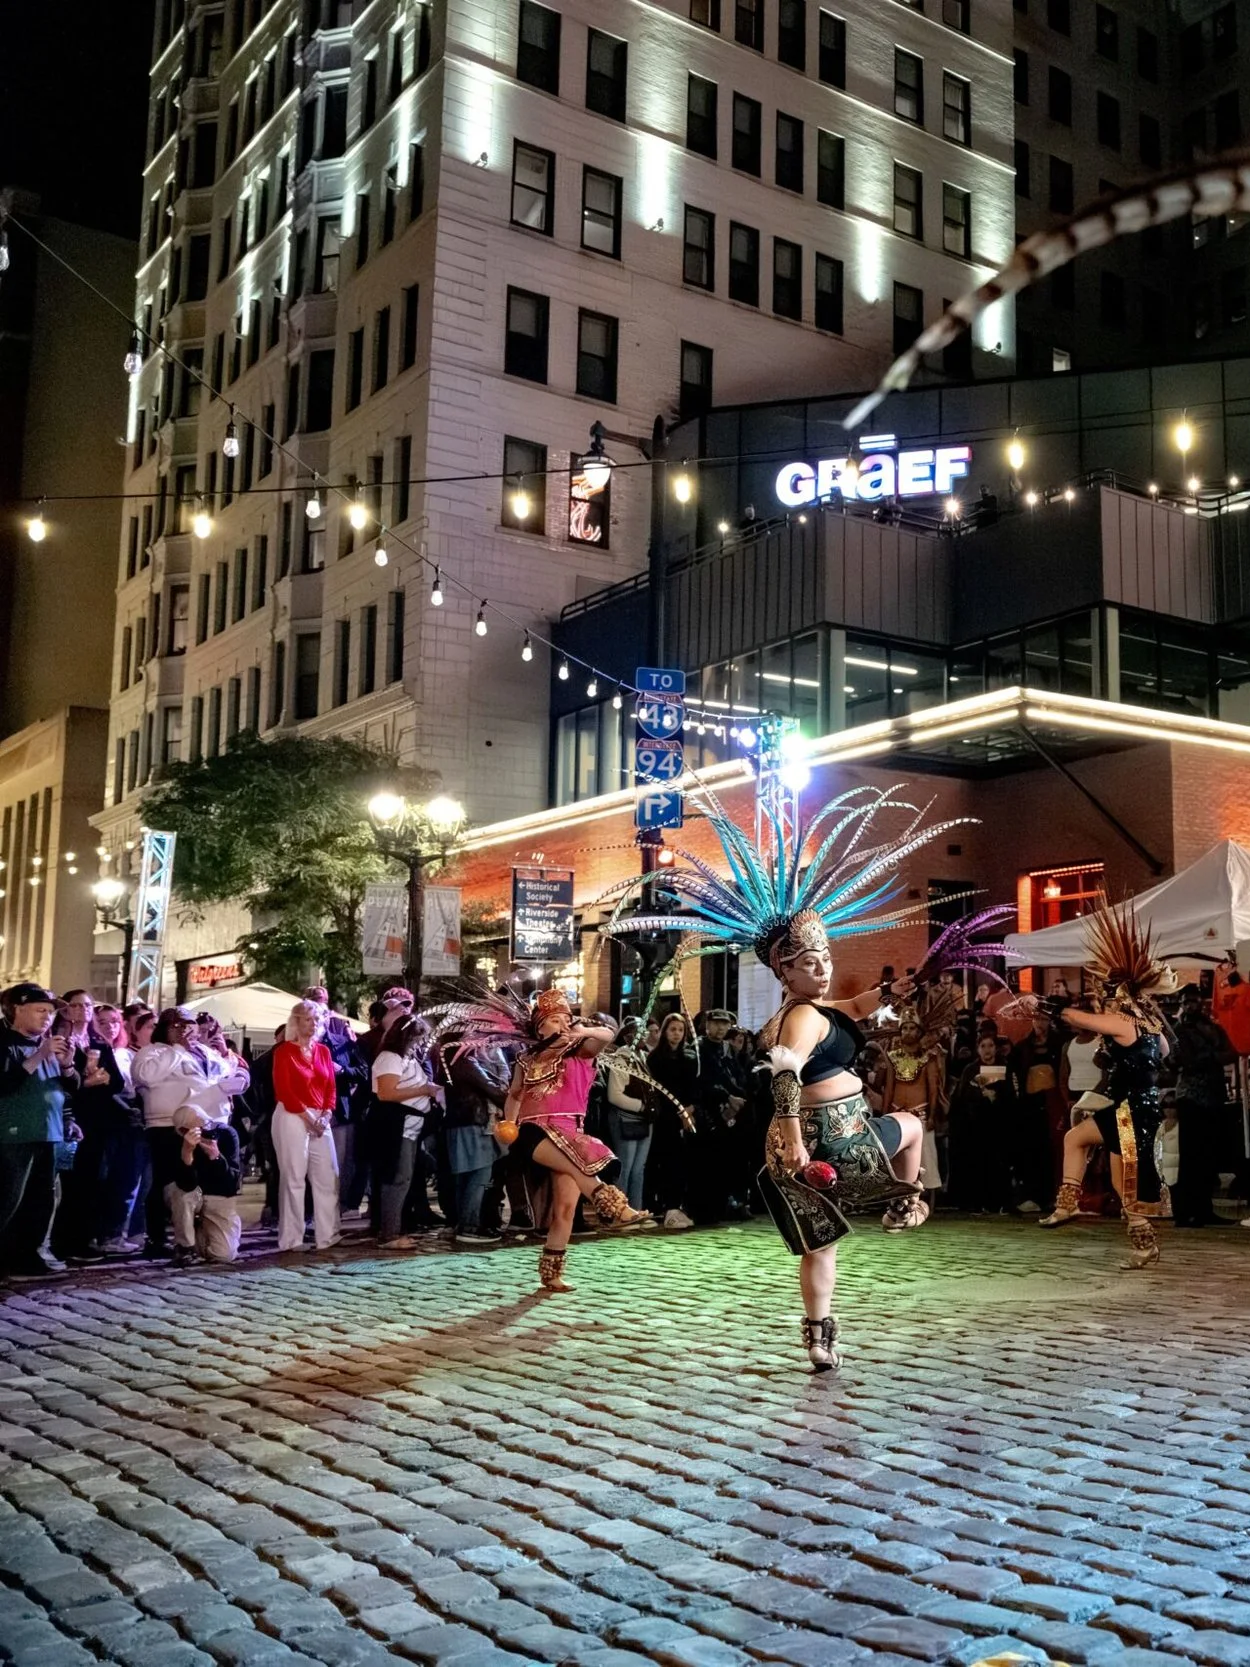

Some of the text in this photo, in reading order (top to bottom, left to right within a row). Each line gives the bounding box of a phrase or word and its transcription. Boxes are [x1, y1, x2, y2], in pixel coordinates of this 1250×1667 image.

[649, 673, 673, 688] TO
[640, 703, 679, 730] 43
[638, 750, 677, 777] 94
[526, 882, 560, 892] Historical
[526, 892, 553, 903] Society
[525, 908, 559, 918] Riverside
[524, 946, 549, 954] Center
